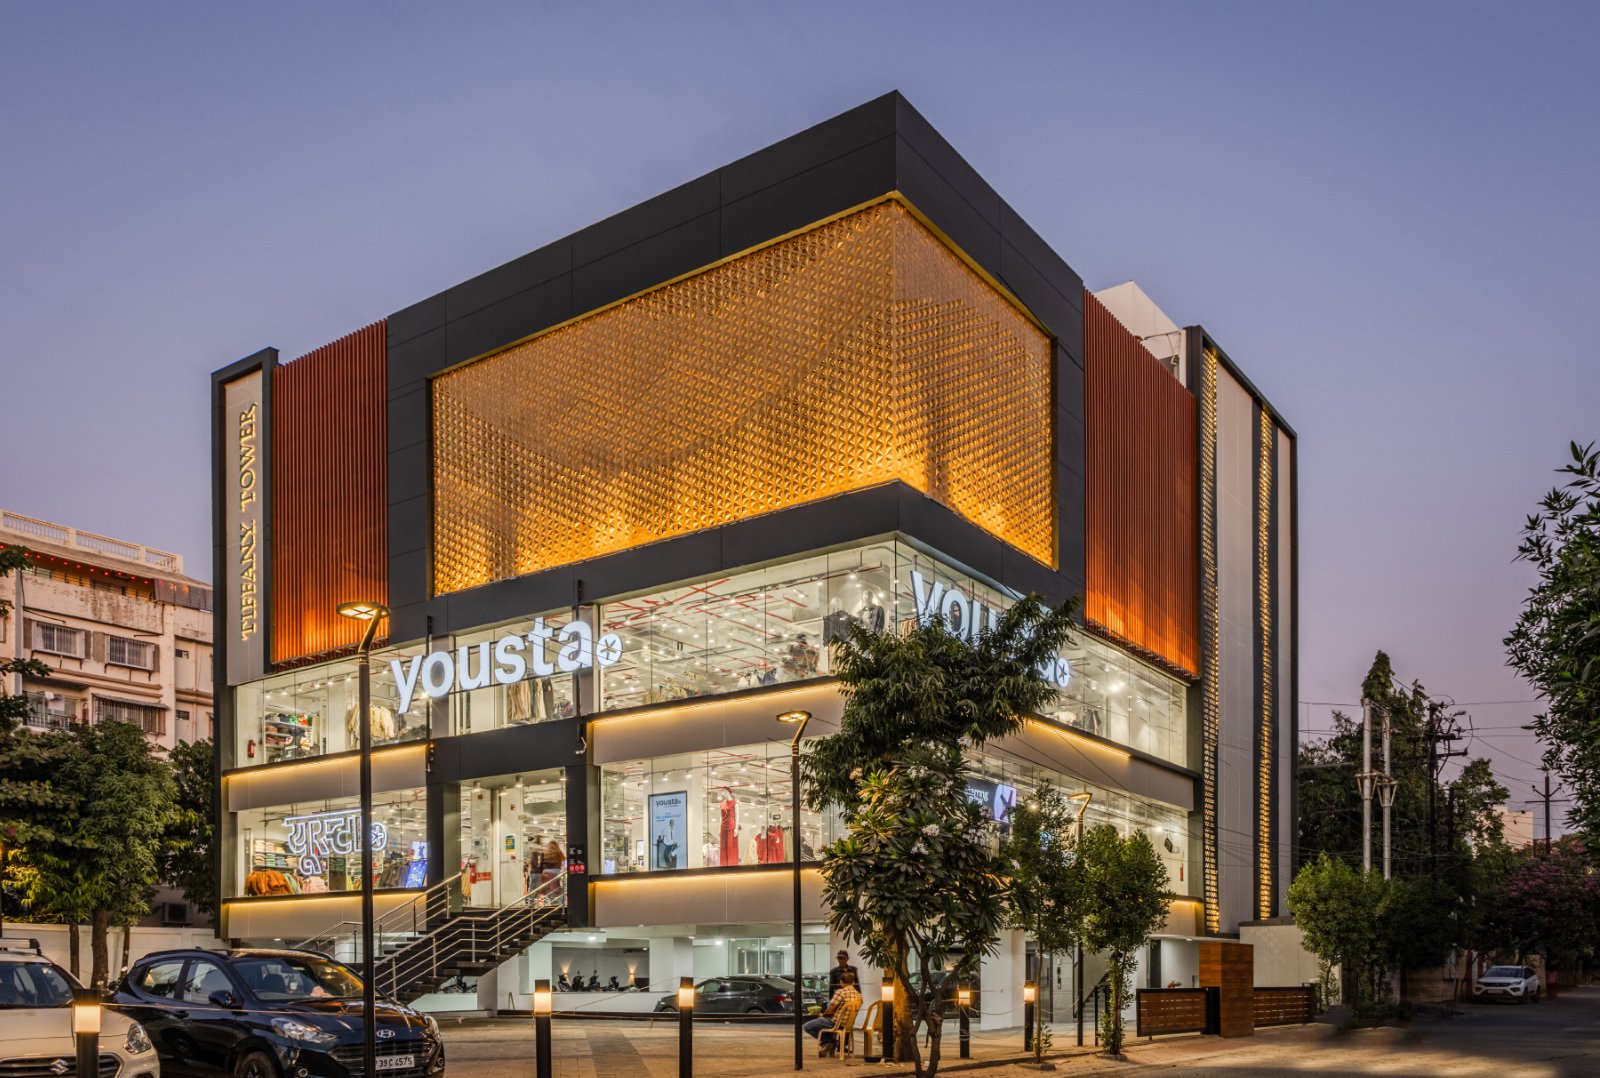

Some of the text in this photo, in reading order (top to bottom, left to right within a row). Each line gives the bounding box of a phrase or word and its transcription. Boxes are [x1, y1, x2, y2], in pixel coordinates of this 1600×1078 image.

[240, 402, 258, 641] TIFFANY TOWER
[390, 616, 593, 714] yousta
